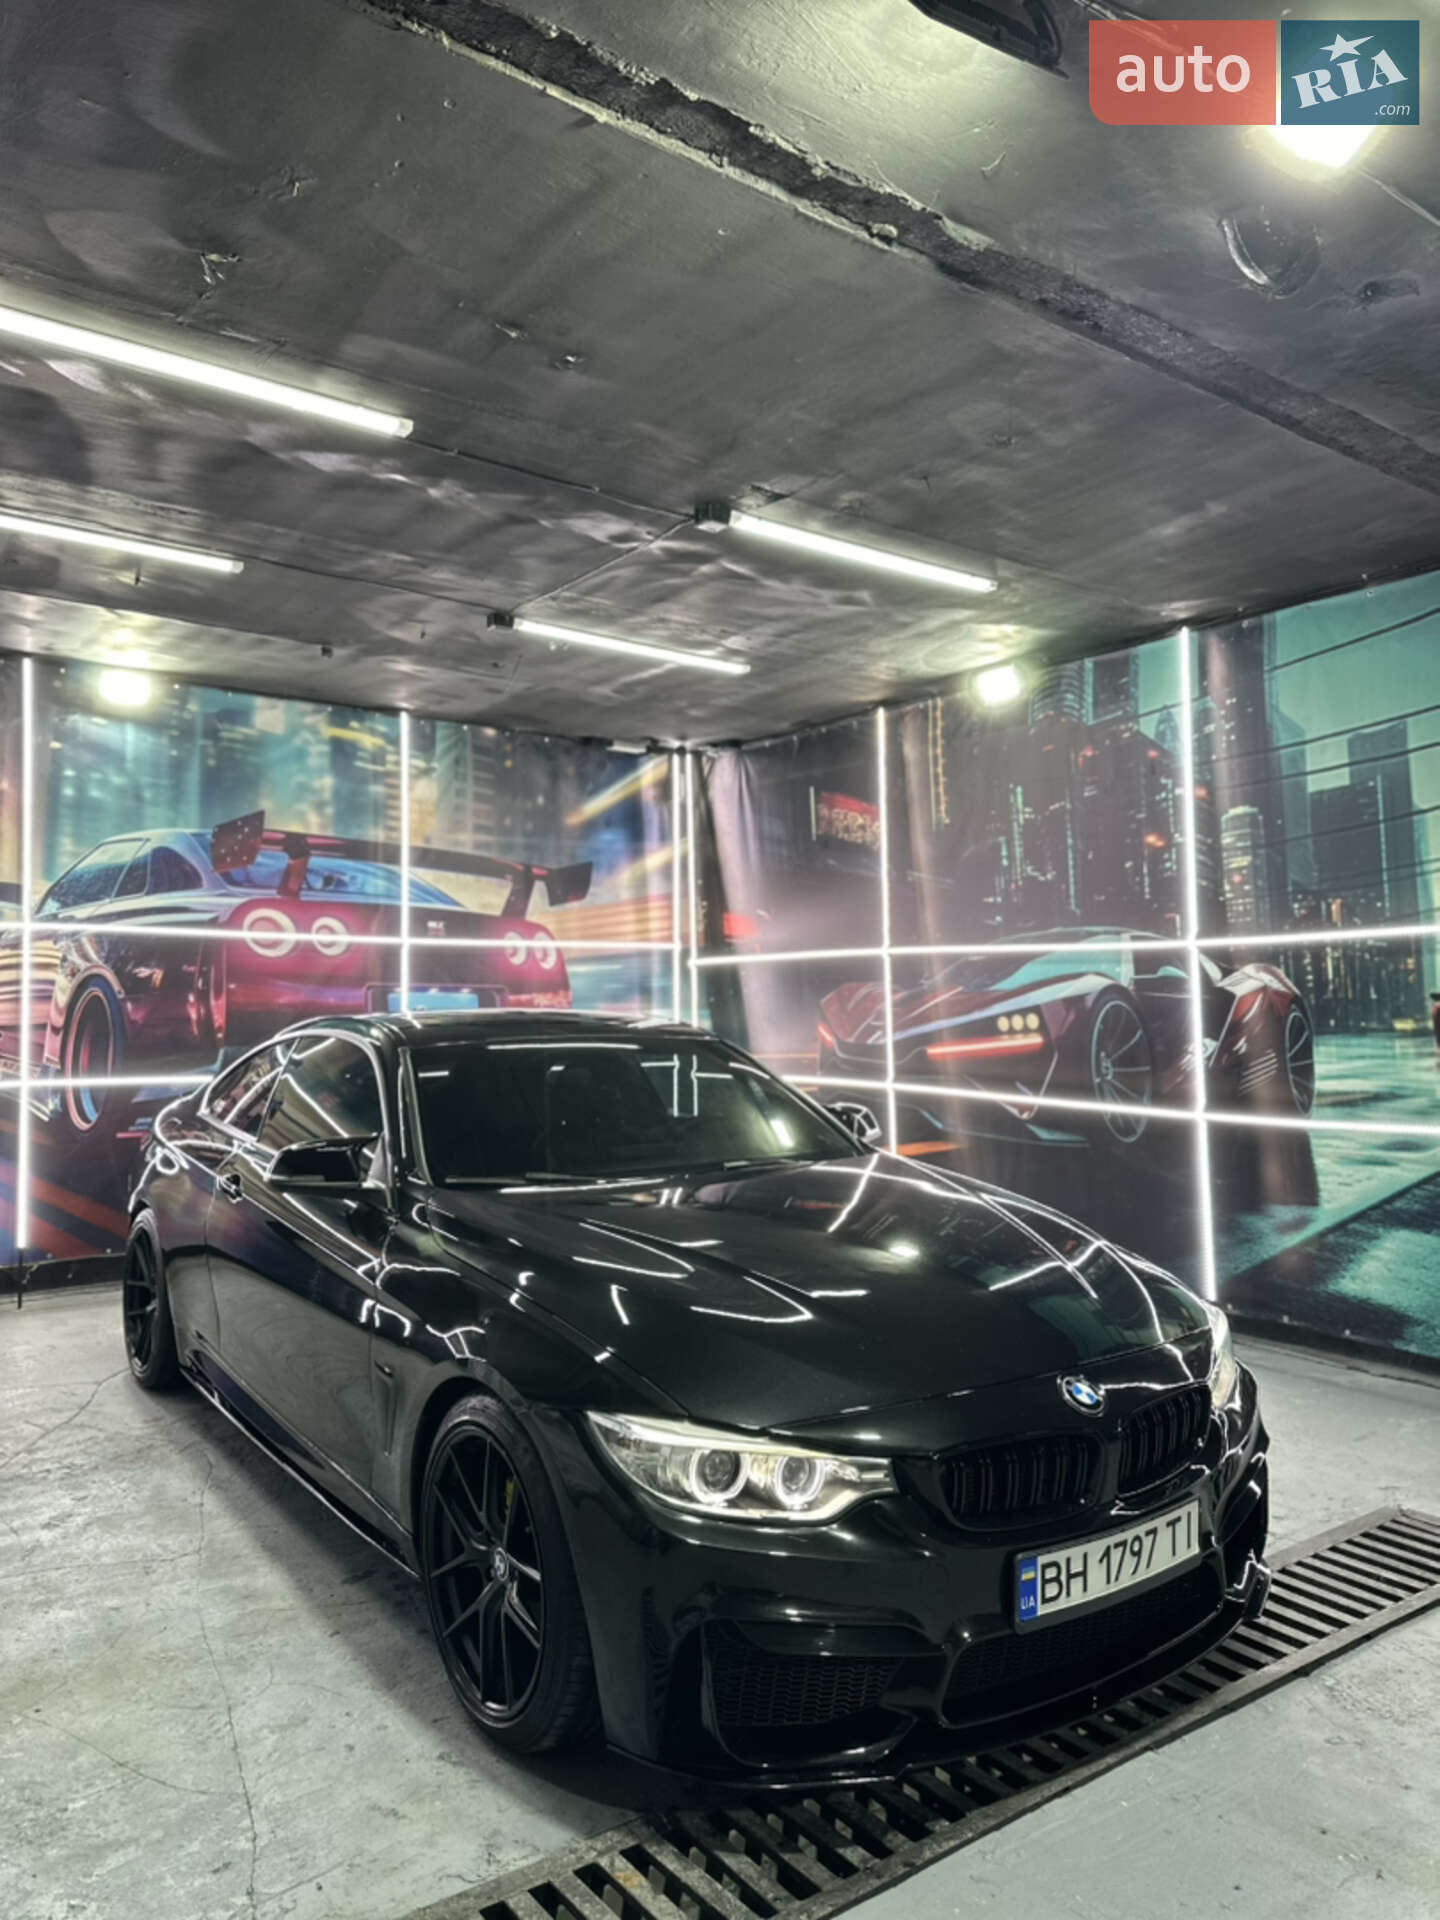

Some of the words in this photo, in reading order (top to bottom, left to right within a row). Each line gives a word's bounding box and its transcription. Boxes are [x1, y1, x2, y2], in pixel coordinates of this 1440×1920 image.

[1040, 1551, 1088, 1605] BH
[1098, 1527, 1158, 1586] 1797
[1166, 1511, 1192, 1557] TI
[1020, 1595, 1036, 1610] UA
